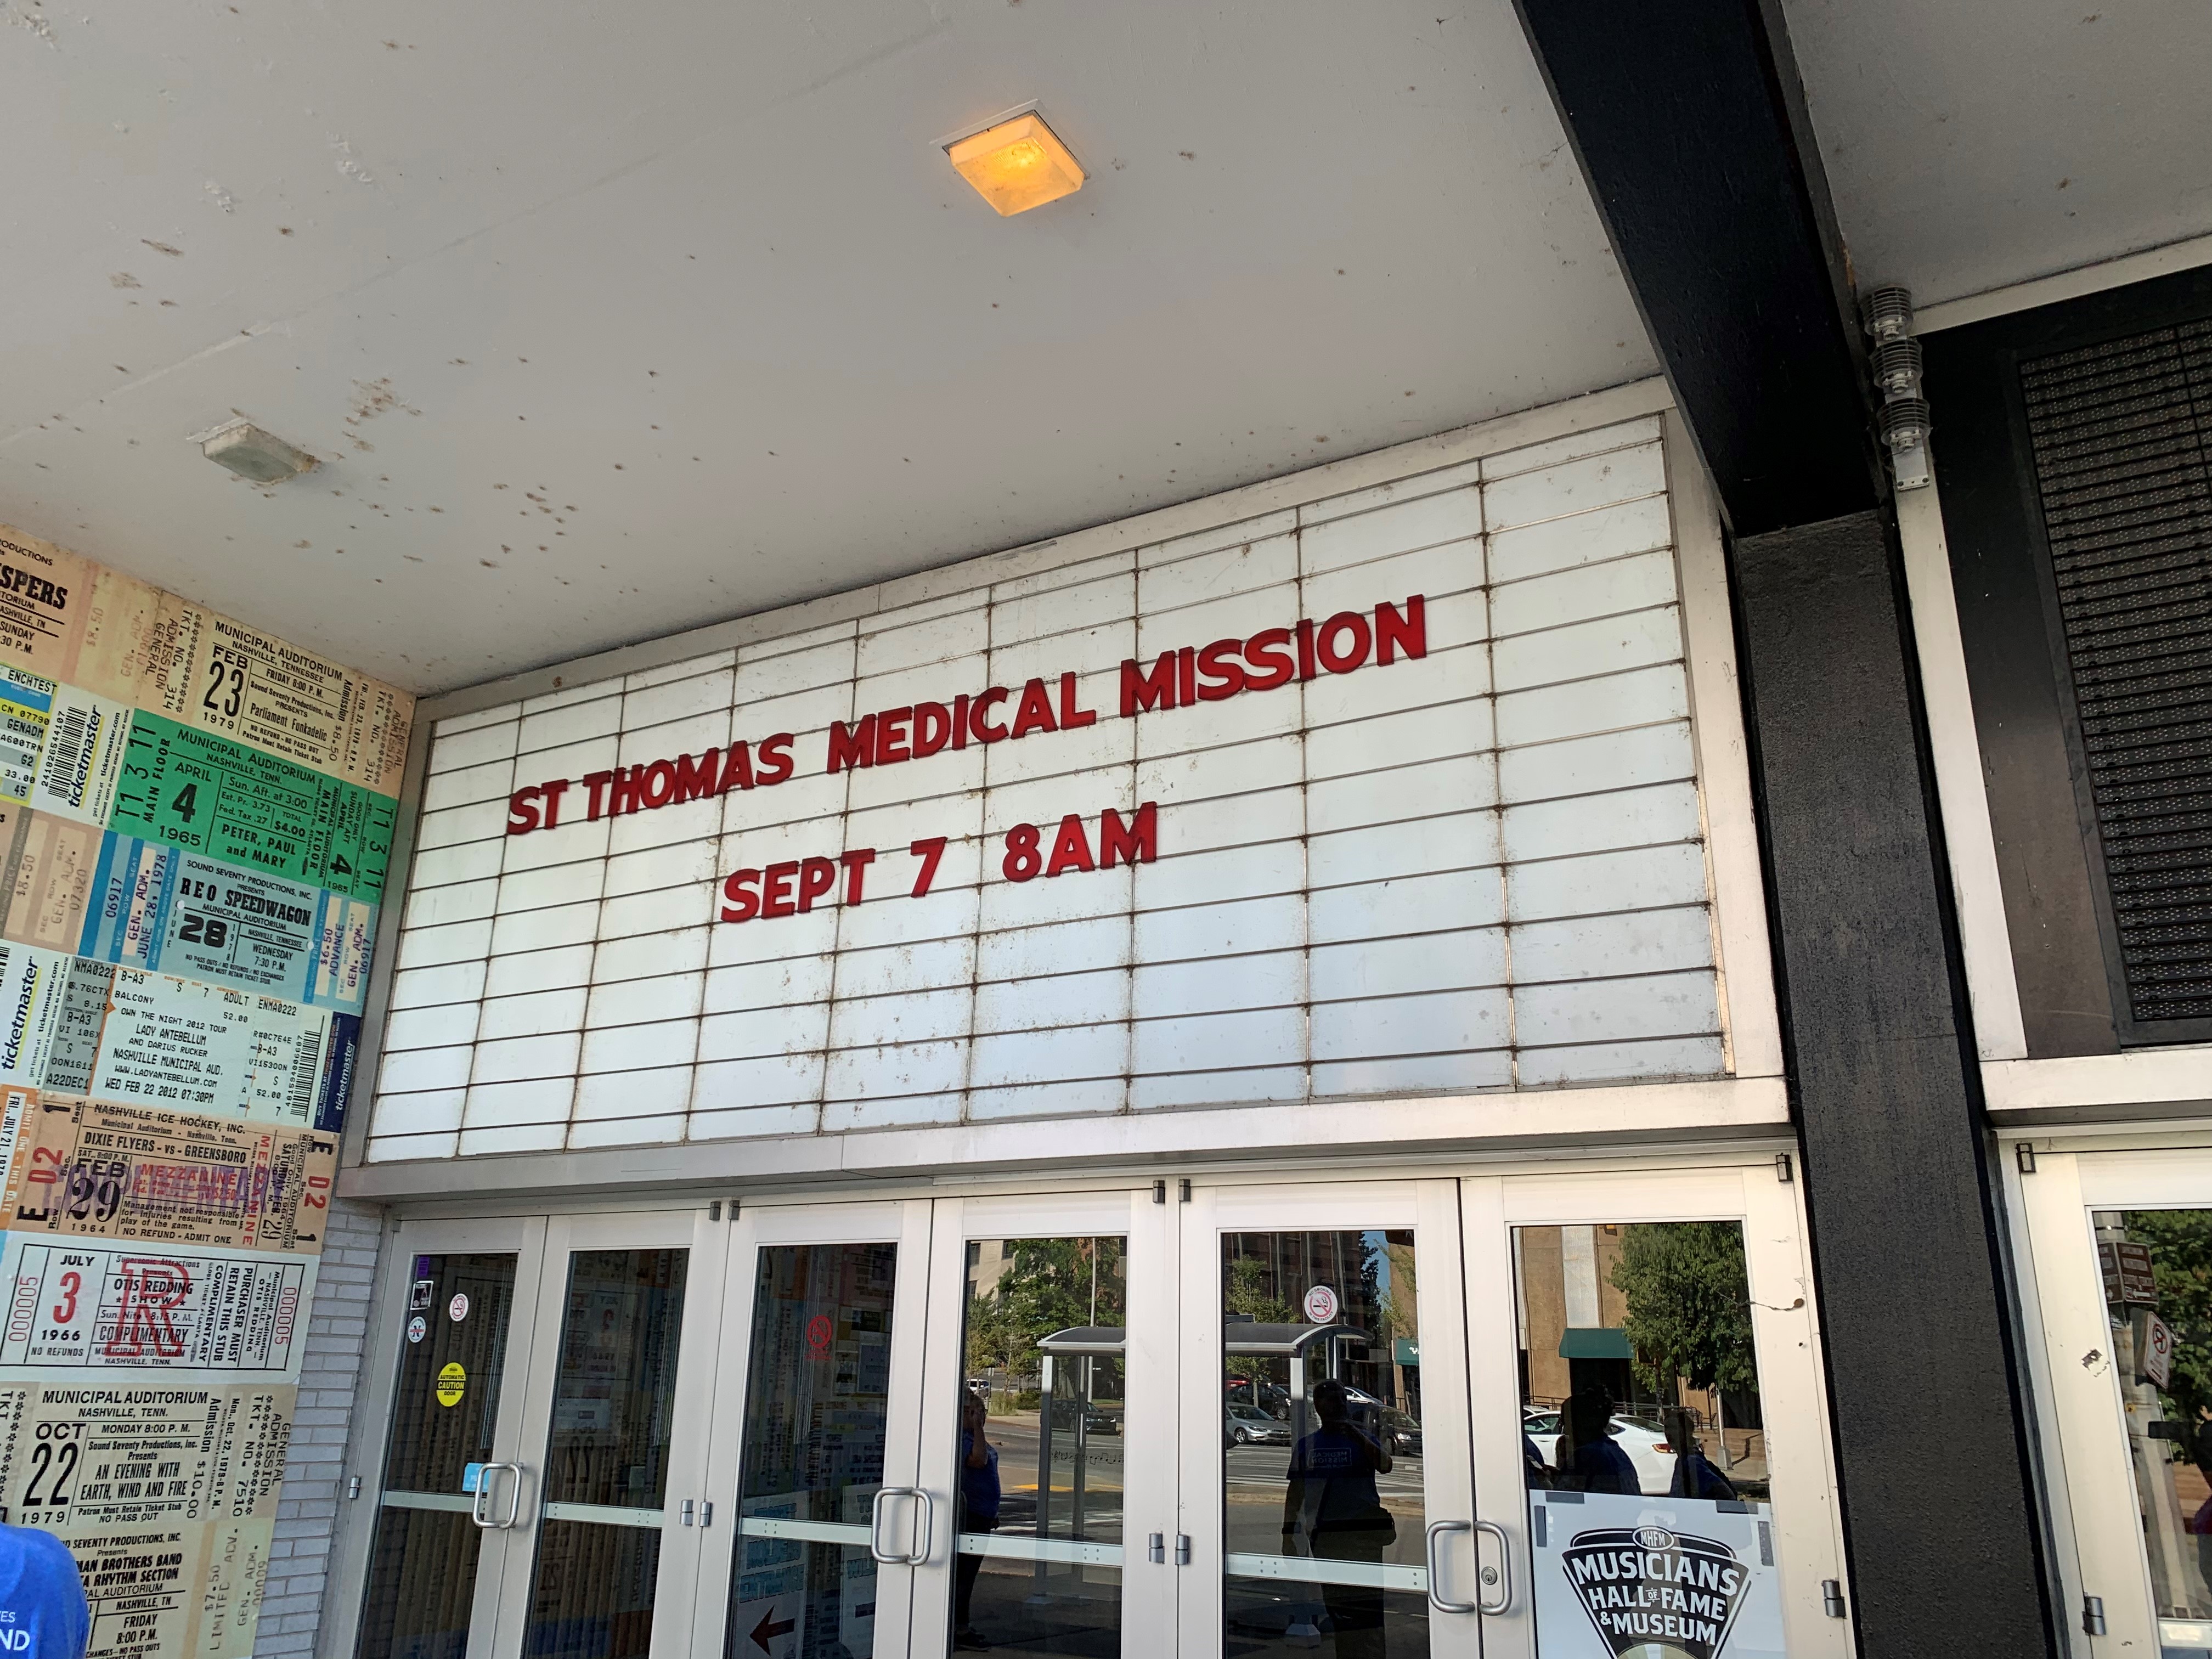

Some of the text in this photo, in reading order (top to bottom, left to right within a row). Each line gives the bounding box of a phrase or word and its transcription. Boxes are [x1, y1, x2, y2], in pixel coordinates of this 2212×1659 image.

[0, 563, 67, 610] SPERS
[145, 623, 166, 676] GENERAL
[212, 645, 248, 669] FEB
[215, 621, 342, 681] MUNICIPAL AUDITORIUM
[8, 670, 57, 695] ENCHTEST
[266, 668, 290, 686] FRIDAY
[281, 660, 324, 684] TENNESSEE
[203, 661, 244, 717] 23
[338, 679, 353, 723] Admission
[204, 712, 234, 730] 1979
[275, 701, 308, 718] PRESENTS
[507, 594, 1427, 835] ST THOMAS MEDICAL MISSION
[7, 719, 44, 738] GENADM
[250, 702, 327, 742] Parliament Funkadelic
[68, 708, 103, 808] ticketmaster
[177, 729, 315, 785] MUNICIPAL AUDITORIUM
[143, 738, 170, 823] MAIN FLOOR
[174, 762, 212, 782] APRIL
[171, 783, 198, 823] 4
[283, 811, 302, 822] TOTAL
[159, 825, 201, 846] 1965
[222, 823, 296, 855] PETER, PAUL
[274, 821, 306, 837] $4.00
[227, 844, 286, 869] and MARY
[720, 801, 1157, 923] SEPT 7 8AM
[187, 859, 298, 897] SOUND SEVENTY PRODUCTIONS,
[237, 883, 265, 896] PRESENTS
[202, 904, 287, 930] MUNICIPAL AUDITORIUM
[225, 890, 312, 926] SPEEDWAGON
[138, 927, 153, 959] JUNE
[178, 913, 227, 949] 28
[252, 943, 294, 961] WEDNESDAY
[329, 923, 346, 977] ADVANCE
[38, 962, 59, 1032] ticketmaster.com
[114, 990, 154, 1005] BALCONY
[224, 992, 249, 1006] ADULT
[258, 998, 297, 1017] ENMA0222
[2, 958, 39, 1070] ticketmaster
[121, 1007, 227, 1034] OWN THE NIGHT 2012 TOUR
[136, 1023, 206, 1046] LADY ANTEBELLUM
[128, 1037, 208, 1058] AND DARIUS RUCKER
[113, 1047, 202, 1073] NASHVILLE MUNICIPAL
[114, 1064, 218, 1088] WWW.LADYANTEBELLUM.COM
[105, 1076, 215, 1104] WED FEB 22 2012 07:30PM
[94, 1104, 222, 1132] NASHVILLE ICE HOCKEY,
[84, 1132, 246, 1164] DIXIE FLYERS GREENSBORO
[75, 1158, 126, 1177] FEB
[66, 1178, 120, 1222] 29
[71, 1223, 106, 1233] 1964
[140, 1229, 231, 1244] REFUND ADMIT ONE
[60, 1255, 95, 1267] JULY
[53, 1271, 82, 1324] 3
[114, 1278, 194, 1295] OTIS REDDING
[1314, 1288, 1331, 1296] SMOKING
[8, 1276, 38, 1341] 000005
[131, 1296, 172, 1305] SHOW
[199, 1265, 224, 1362] COMPLIMENTARY
[213, 1267, 240, 1362] RETAIN THIS STUB
[228, 1267, 253, 1363] PURCHASER MUST
[274, 1287, 297, 1345] 000005
[1321, 1311, 1333, 1321] FACILITY
[42, 1329, 81, 1341] 1966
[99, 1325, 189, 1344] COMPLIMENTARY
[31, 1347, 83, 1357] NO REFUNDS
[42, 1390, 208, 1404] MUNICIPAL AUDITORIUM
[438, 1381, 465, 1389] CAUTION
[78, 1408, 168, 1419] NASHVILLE, TENN.
[201, 1398, 222, 1453] Admission
[35, 1423, 87, 1440] OCT
[101, 1424, 165, 1434] MONDAY 8:00
[258, 1413, 282, 1497] ADMISSION
[272, 1423, 291, 1486] GENERAL
[22, 1442, 78, 1506] 22
[95, 1462, 180, 1480] AN EVENING WITH
[80, 1480, 188, 1501] EARTH, WIND AND FIRE
[21, 1511, 65, 1524] 1979
[73, 1533, 166, 1550] SEVENTY PRODUCTIONS,
[1640, 1530, 1666, 1547] MHFM
[102, 1552, 182, 1572] BROTHERS BAND
[1571, 1551, 1739, 1596] MUSICIANS
[94, 1566, 179, 1587] RHYTHM SECTION
[102, 1583, 163, 1598] AUDITORIUM
[116, 1598, 160, 1611] NASHVILLE,
[1589, 1586, 1726, 1621] HALL OF FAME
[0, 1611, 16, 1623] ES
[124, 1613, 158, 1628] FRIDAY
